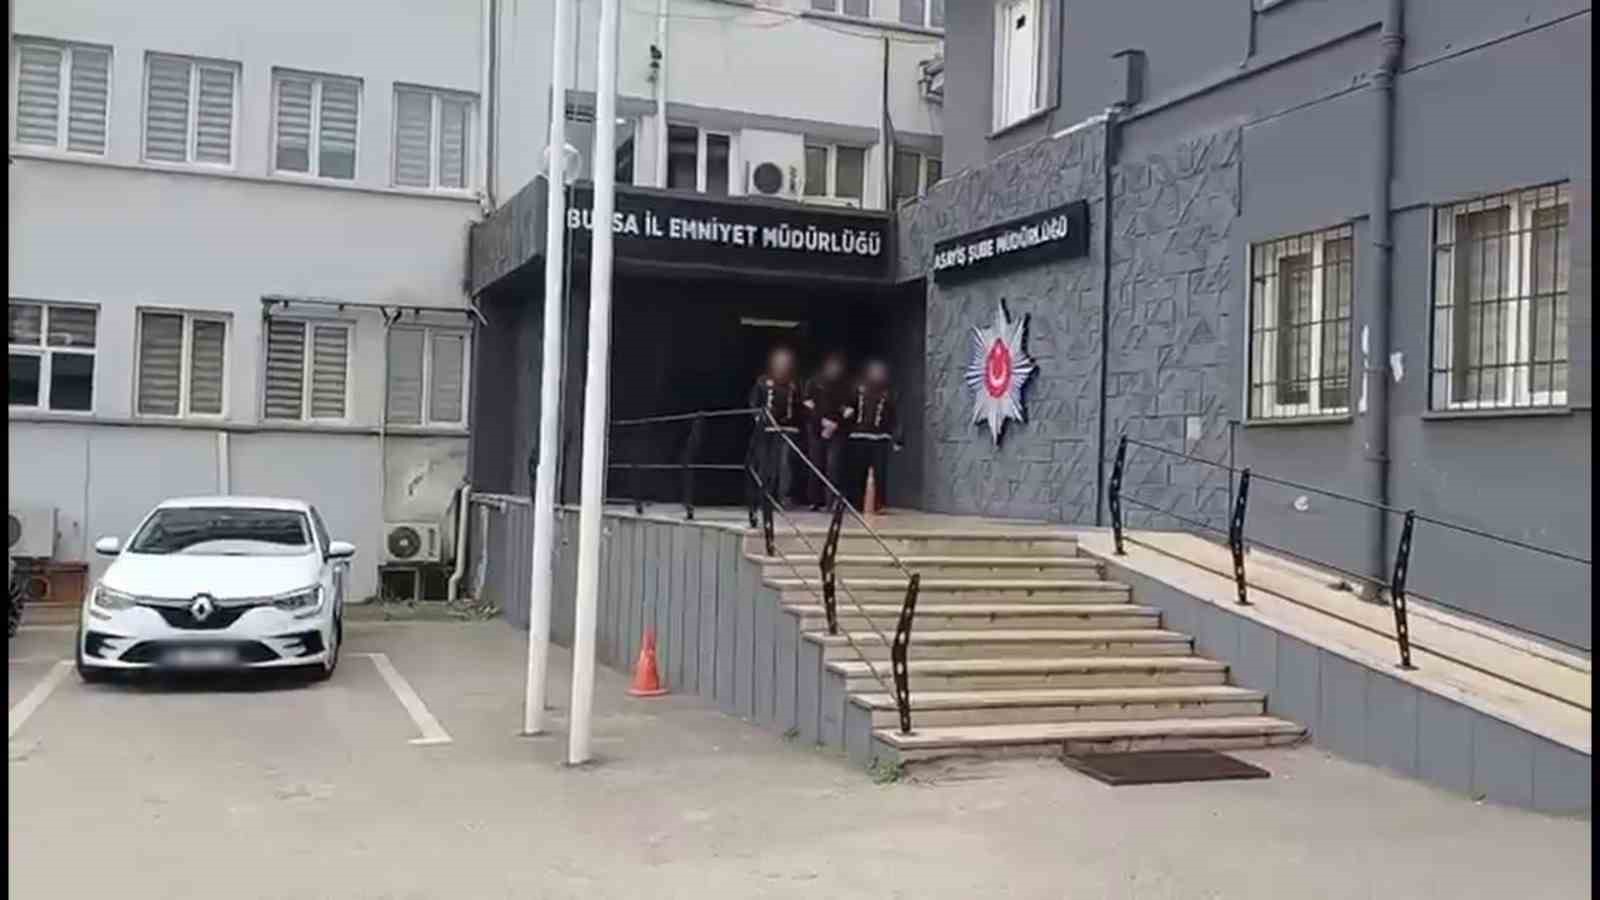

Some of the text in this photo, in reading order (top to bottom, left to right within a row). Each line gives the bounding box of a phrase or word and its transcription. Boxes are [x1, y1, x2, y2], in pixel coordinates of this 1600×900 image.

[567, 208, 881, 256] BUSA İL EMNİYET MÜDÜRLÜĞÜ
